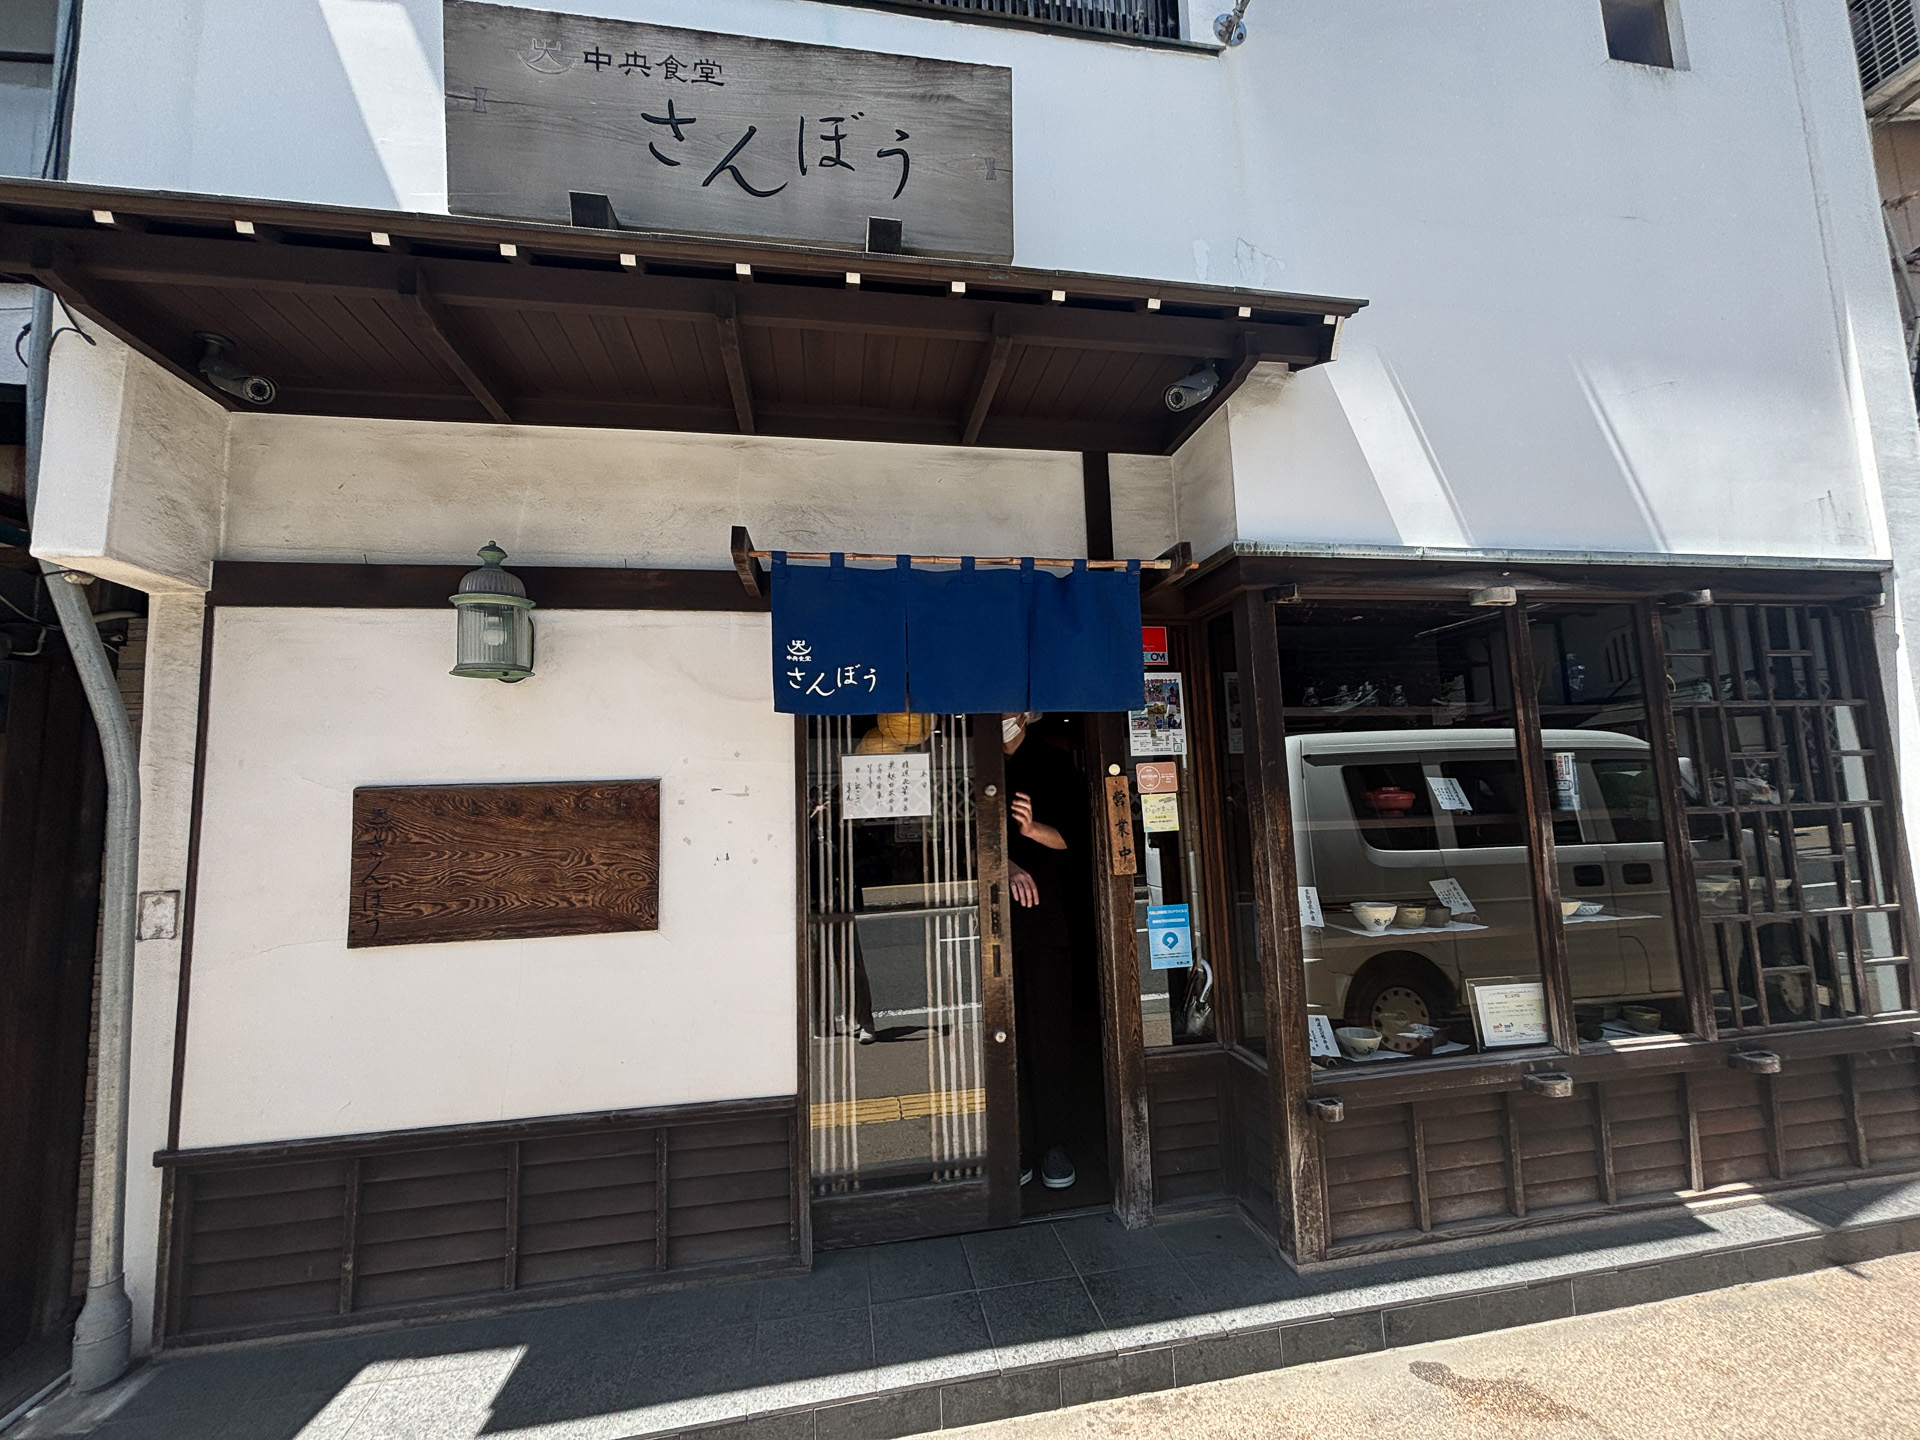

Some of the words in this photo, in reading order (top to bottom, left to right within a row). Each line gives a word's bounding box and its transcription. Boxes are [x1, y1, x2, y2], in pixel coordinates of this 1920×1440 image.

[583, 46, 725, 87] 中央食堂
[640, 98, 908, 200] さんぼう
[786, 663, 877, 697] さんぼう
[1112, 789, 1132, 862] 営業中
